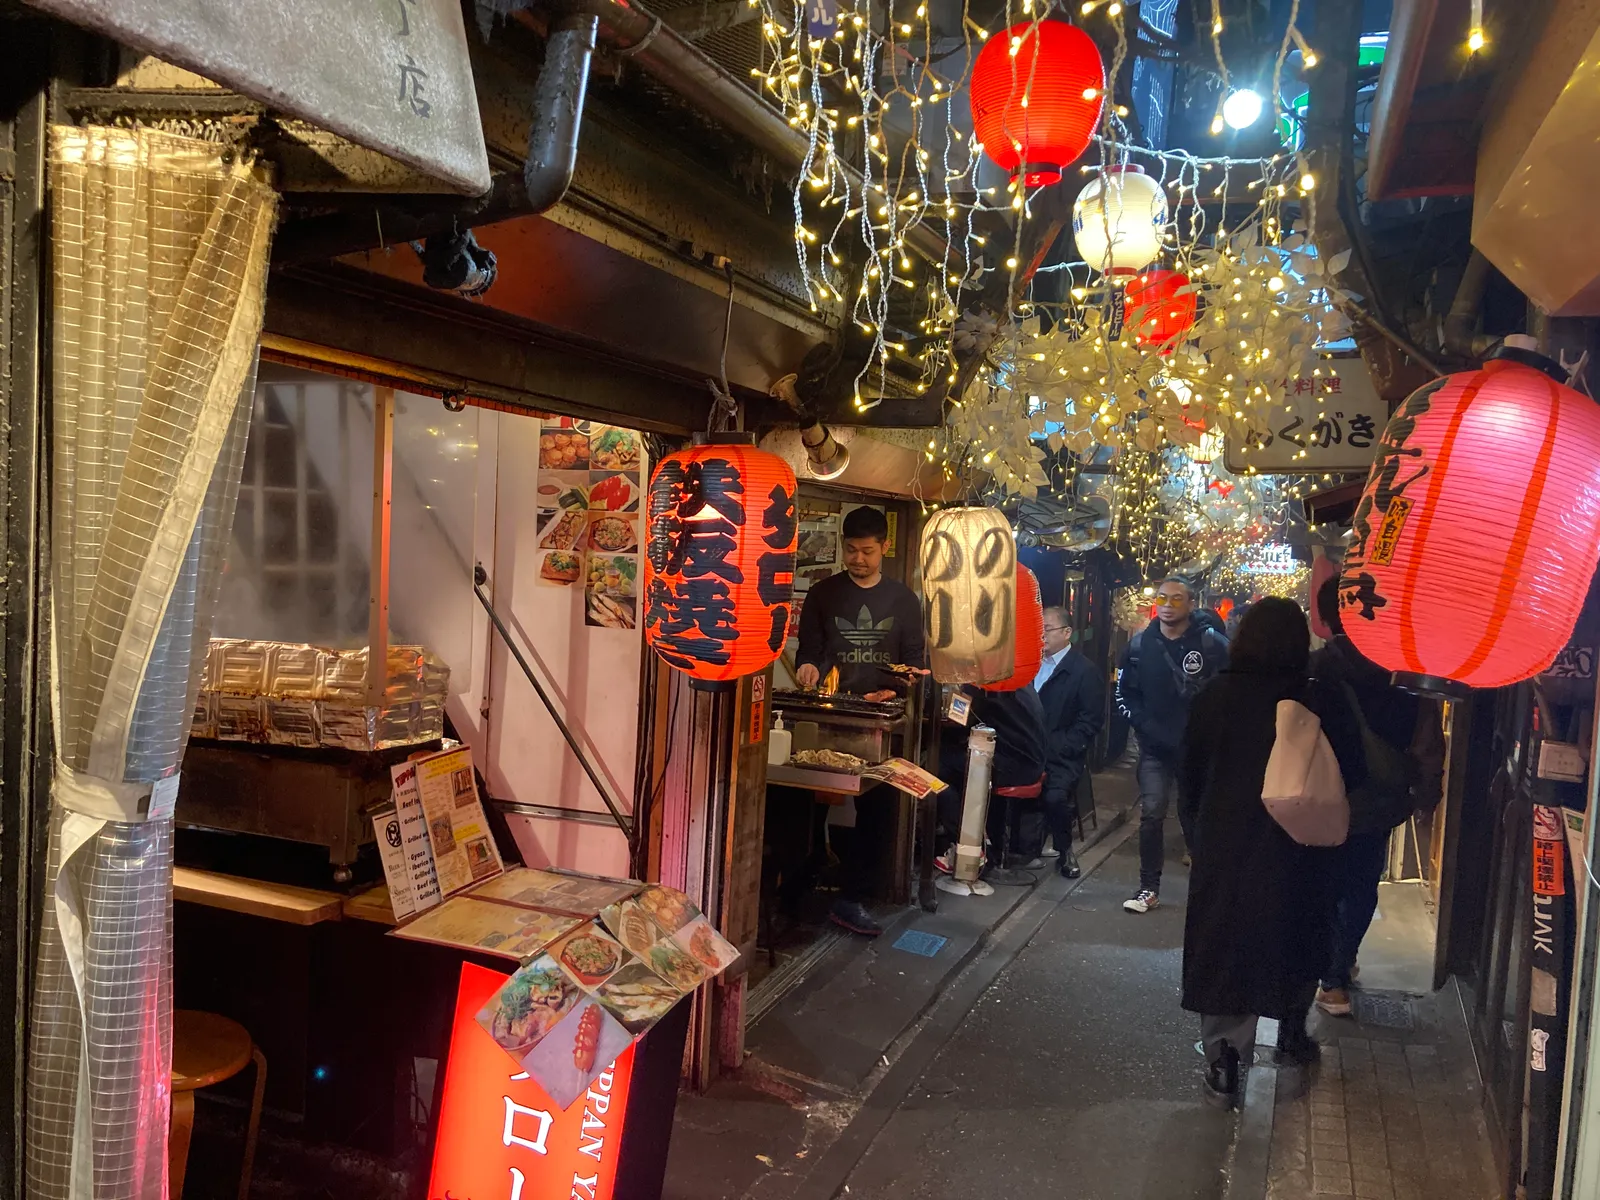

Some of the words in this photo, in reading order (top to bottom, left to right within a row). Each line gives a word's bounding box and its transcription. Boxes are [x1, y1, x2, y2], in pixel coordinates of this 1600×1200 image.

[757, 482, 797, 653] タロー
[1373, 501, 1409, 564] 味自慢
[836, 648, 891, 663] adidas
[411, 850, 426, 861] Gyoza
[502, 1070, 554, 1200] ロー
[577, 1060, 616, 1162] PPAN
